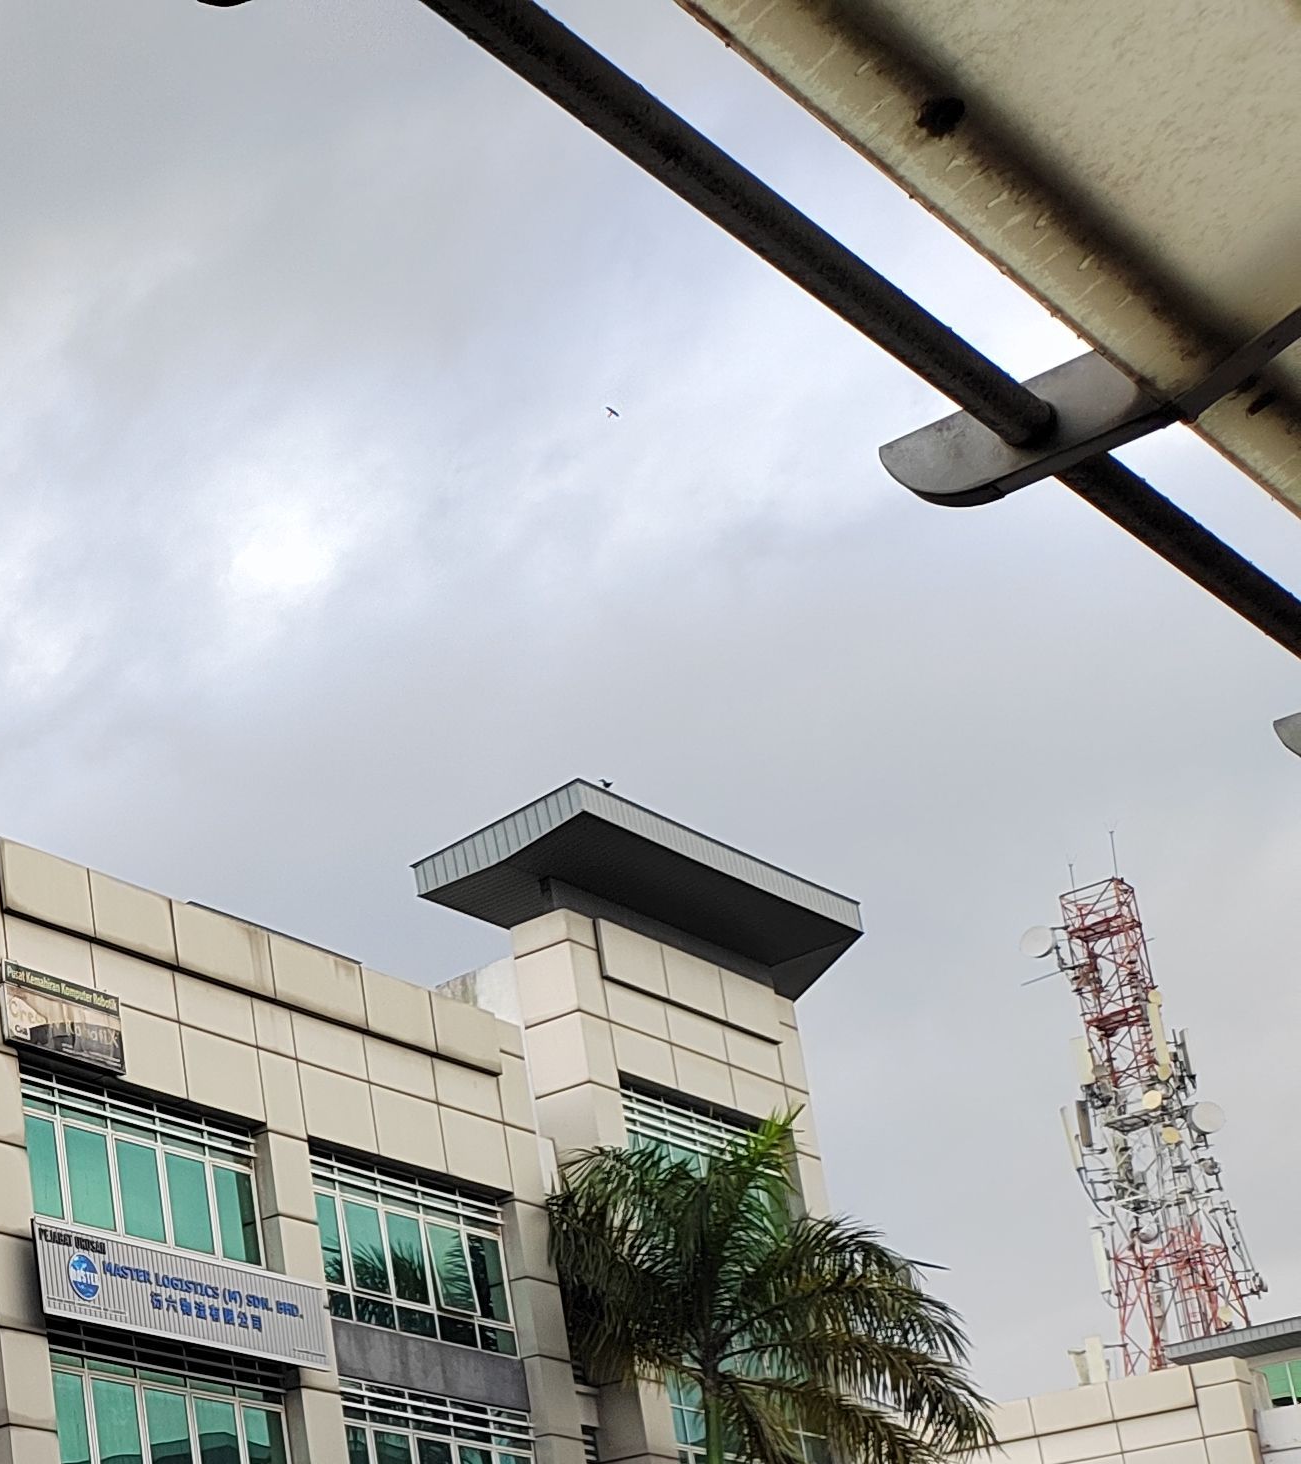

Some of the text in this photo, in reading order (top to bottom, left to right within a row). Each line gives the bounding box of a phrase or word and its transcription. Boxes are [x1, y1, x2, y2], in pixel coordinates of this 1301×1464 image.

[102, 1260, 152, 1285] MASTER
[155, 1272, 219, 1298] LOGISTICS
[223, 1288, 242, 1308] (M)
